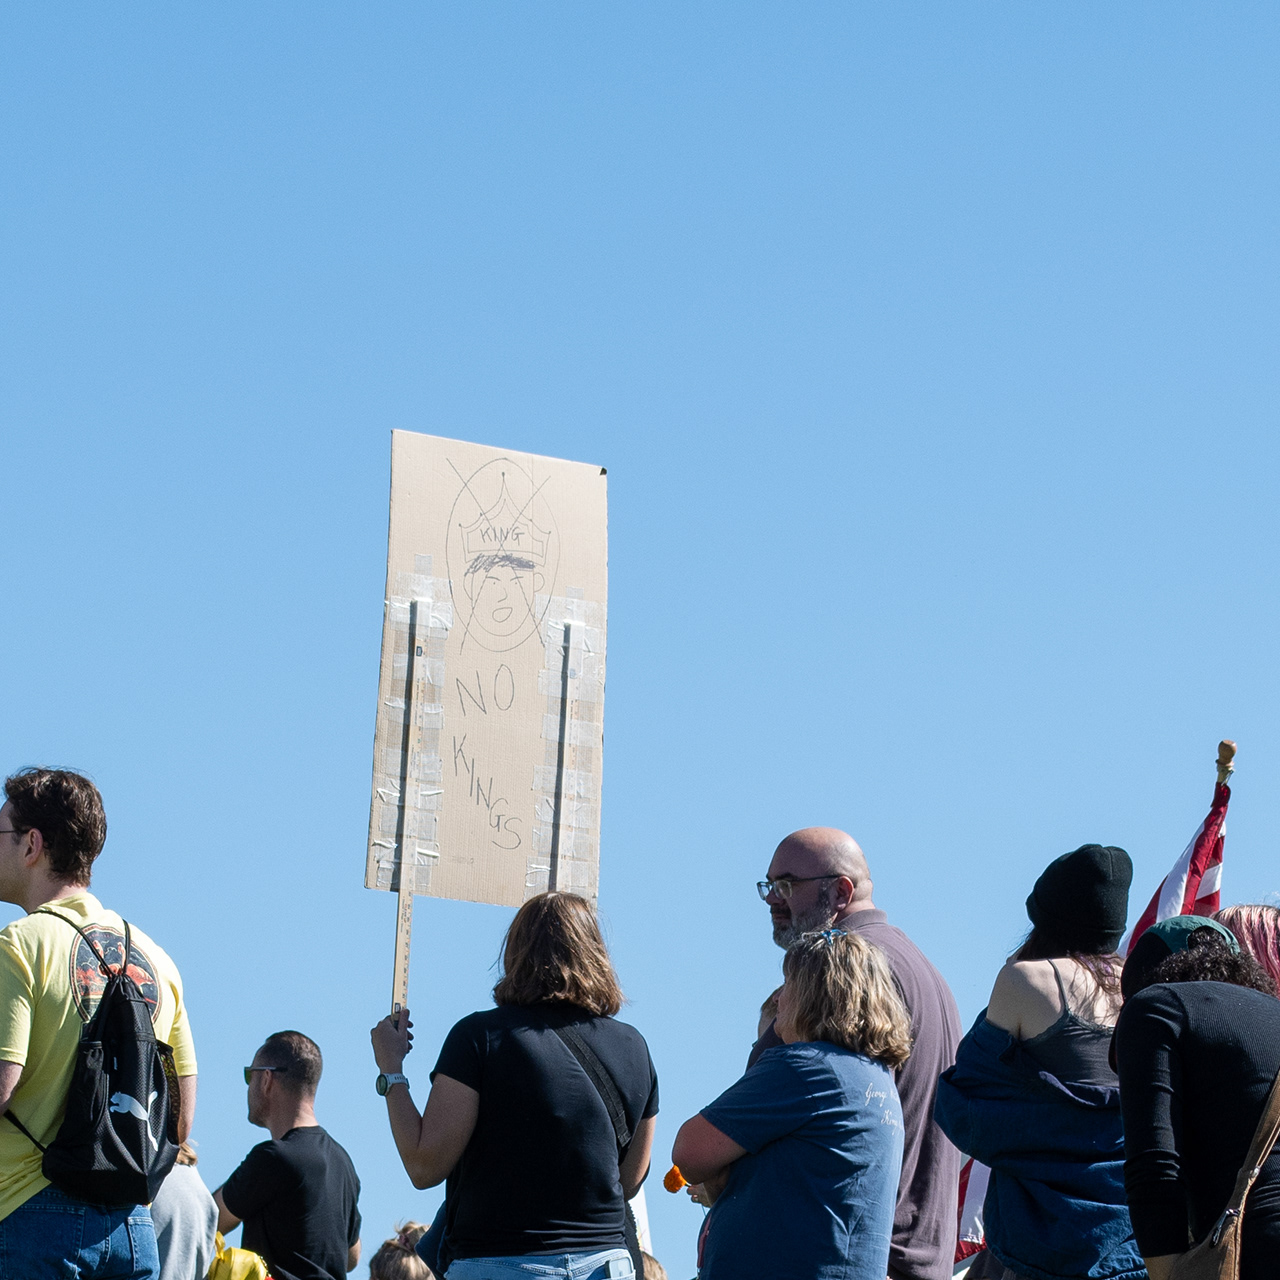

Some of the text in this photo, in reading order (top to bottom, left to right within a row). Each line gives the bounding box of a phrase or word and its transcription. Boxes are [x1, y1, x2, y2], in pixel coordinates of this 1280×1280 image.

[480, 525, 526, 545] KING
[456, 664, 515, 717] NO
[453, 733, 523, 851] KINGS
